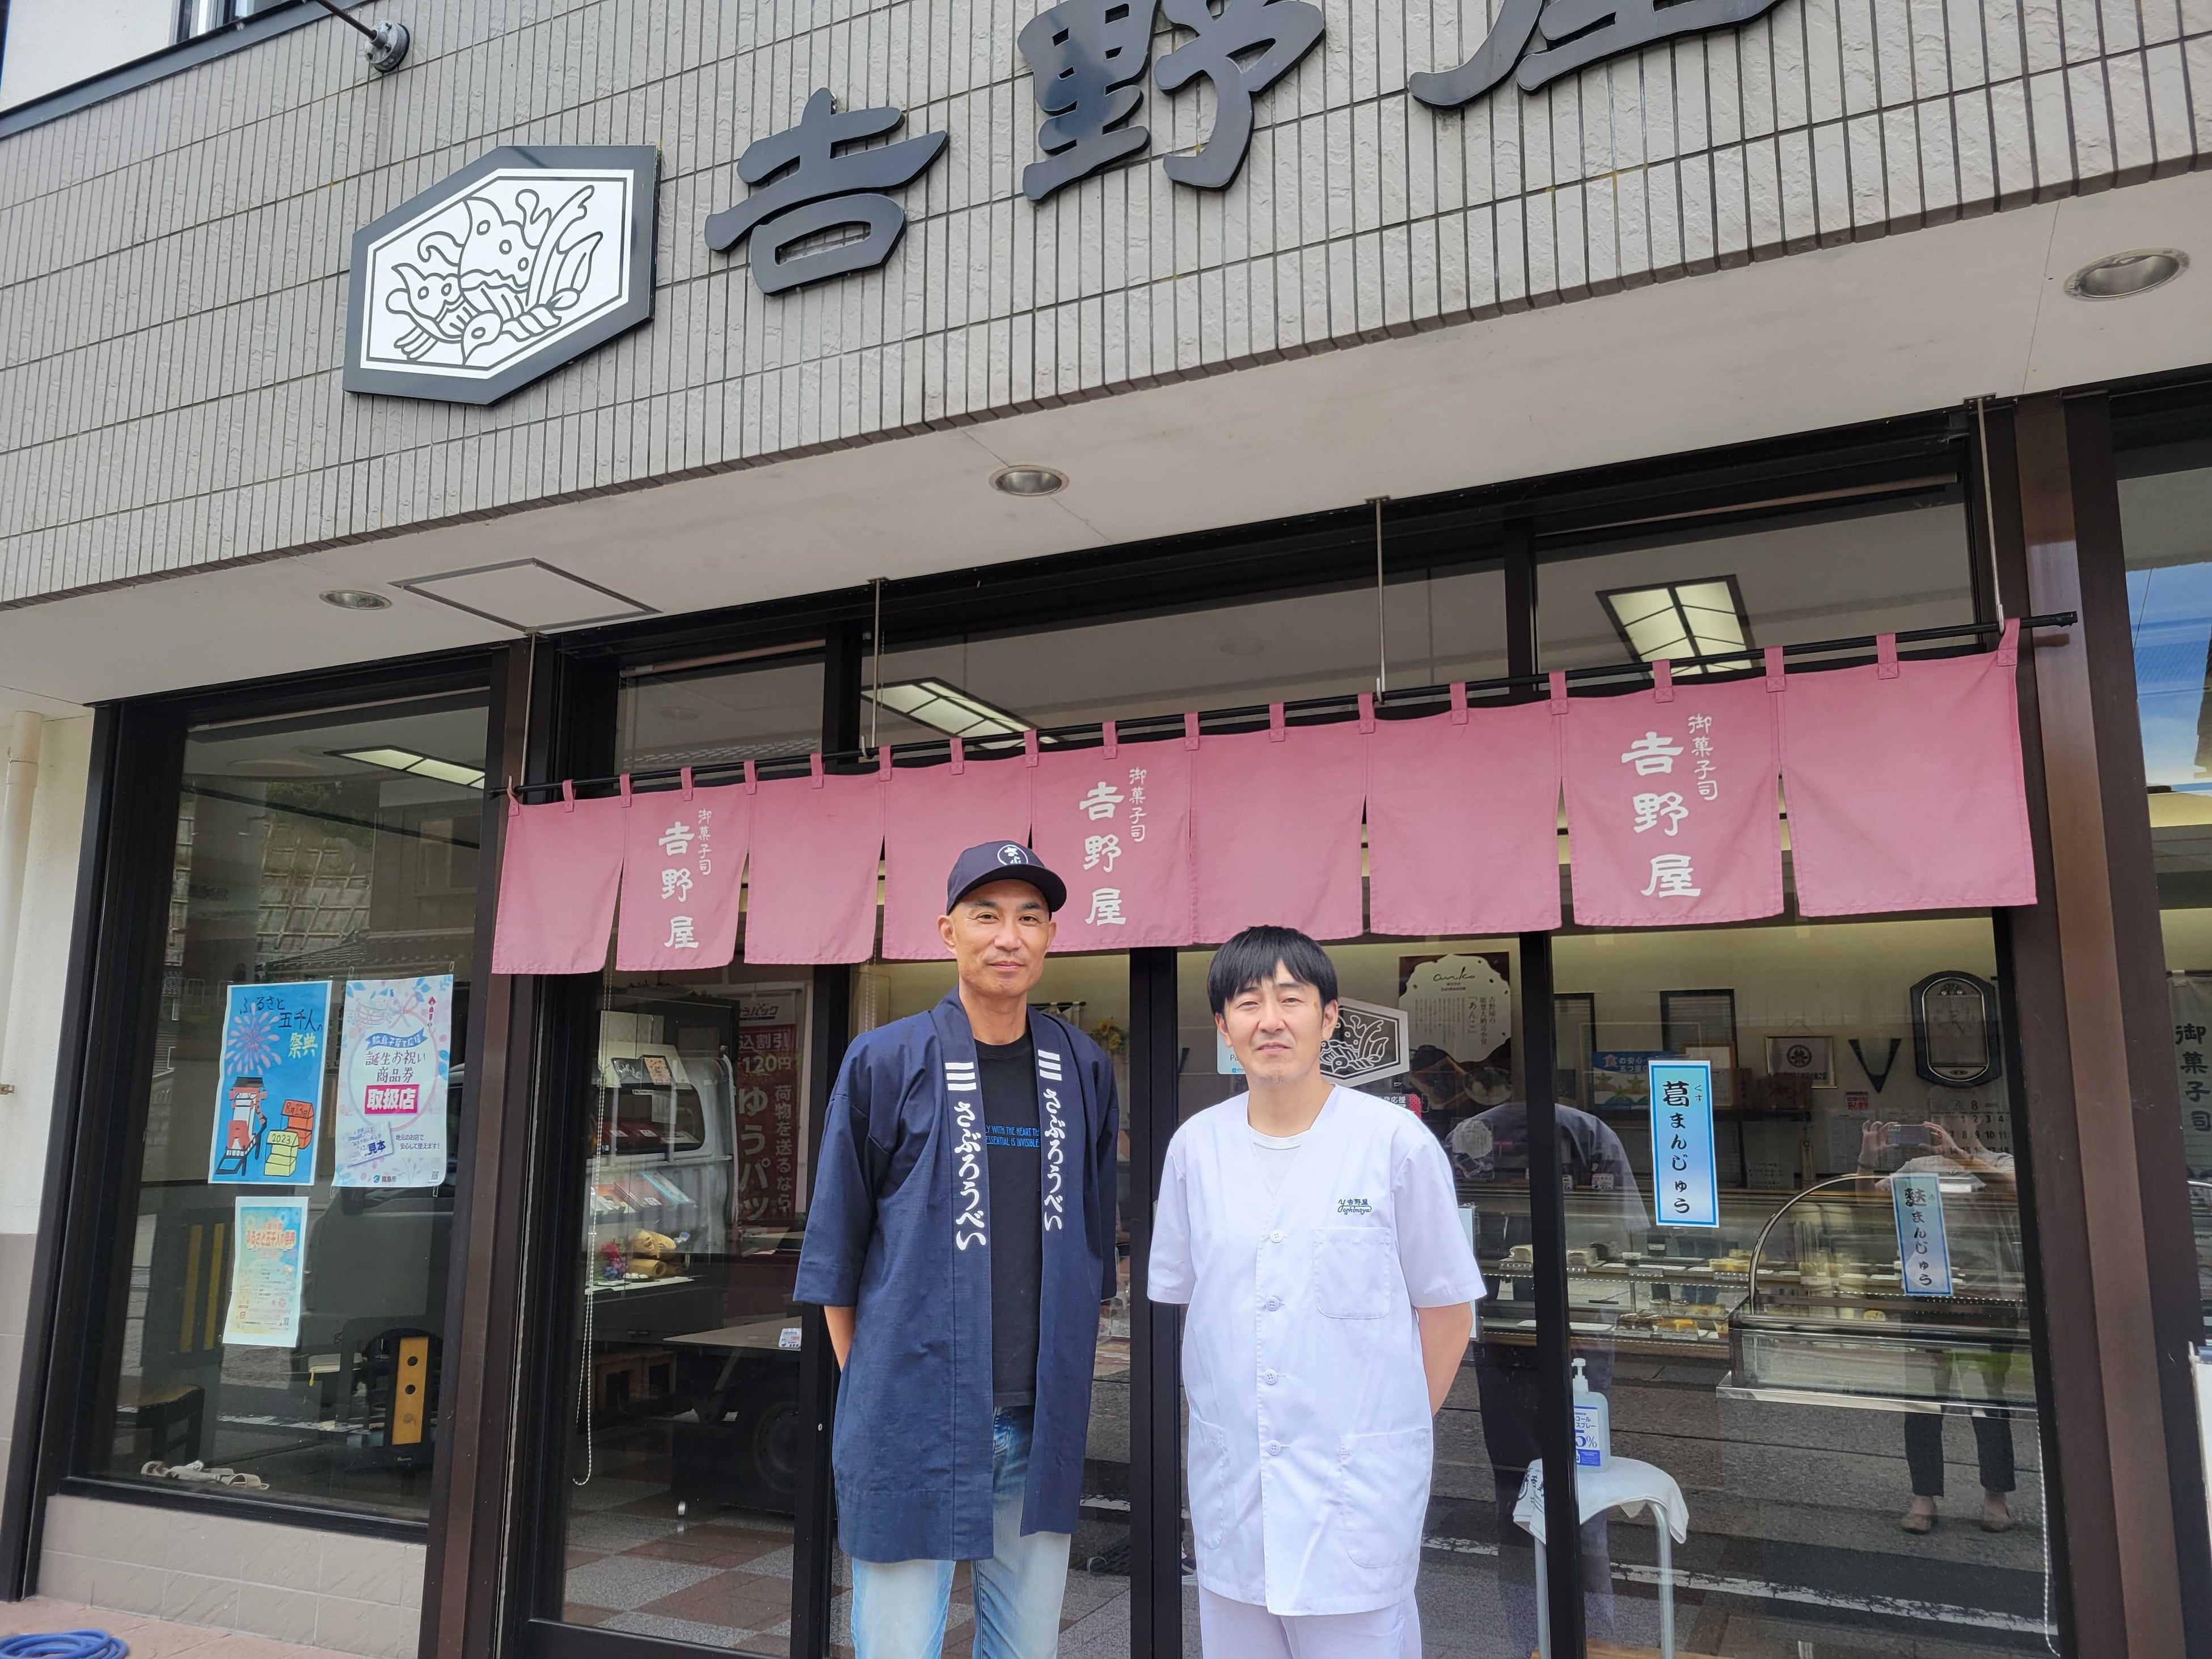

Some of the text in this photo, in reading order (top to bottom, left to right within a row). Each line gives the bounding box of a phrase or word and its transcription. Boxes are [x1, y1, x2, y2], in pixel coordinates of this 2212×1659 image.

[1688, 714, 1719, 800] 御菓子司
[1129, 766, 1147, 842] 御菓子司
[1622, 731, 1702, 898] 吉野屋
[698, 808, 712, 875] 御菓子司
[1079, 782, 1126, 926] 吉野屋
[658, 821, 699, 949] 吉野屋
[240, 996, 285, 1014] ふるさと
[740, 1003, 779, 1016] うパック
[288, 1032, 318, 1058] 祭典
[366, 1050, 426, 1066] 誕生お祝い
[377, 1067, 413, 1083] 商品券
[2176, 1023, 2211, 1132] 御菓子司
[366, 1088, 416, 1111] 取扱店
[1971, 1100, 1978, 1110] 8
[272, 1134, 291, 1145] 2023
[991, 1125, 1005, 1134] WITH
[1006, 1126, 1015, 1135] THE
[1016, 1128, 1032, 1136] HEART
[1017, 1138, 1040, 1147] INVISIBLE
[369, 1140, 386, 1155] 見本
[774, 1084, 792, 1213] 荷物を送るなら
[1662, 1080, 1690, 1214] 葛まんじゅう
